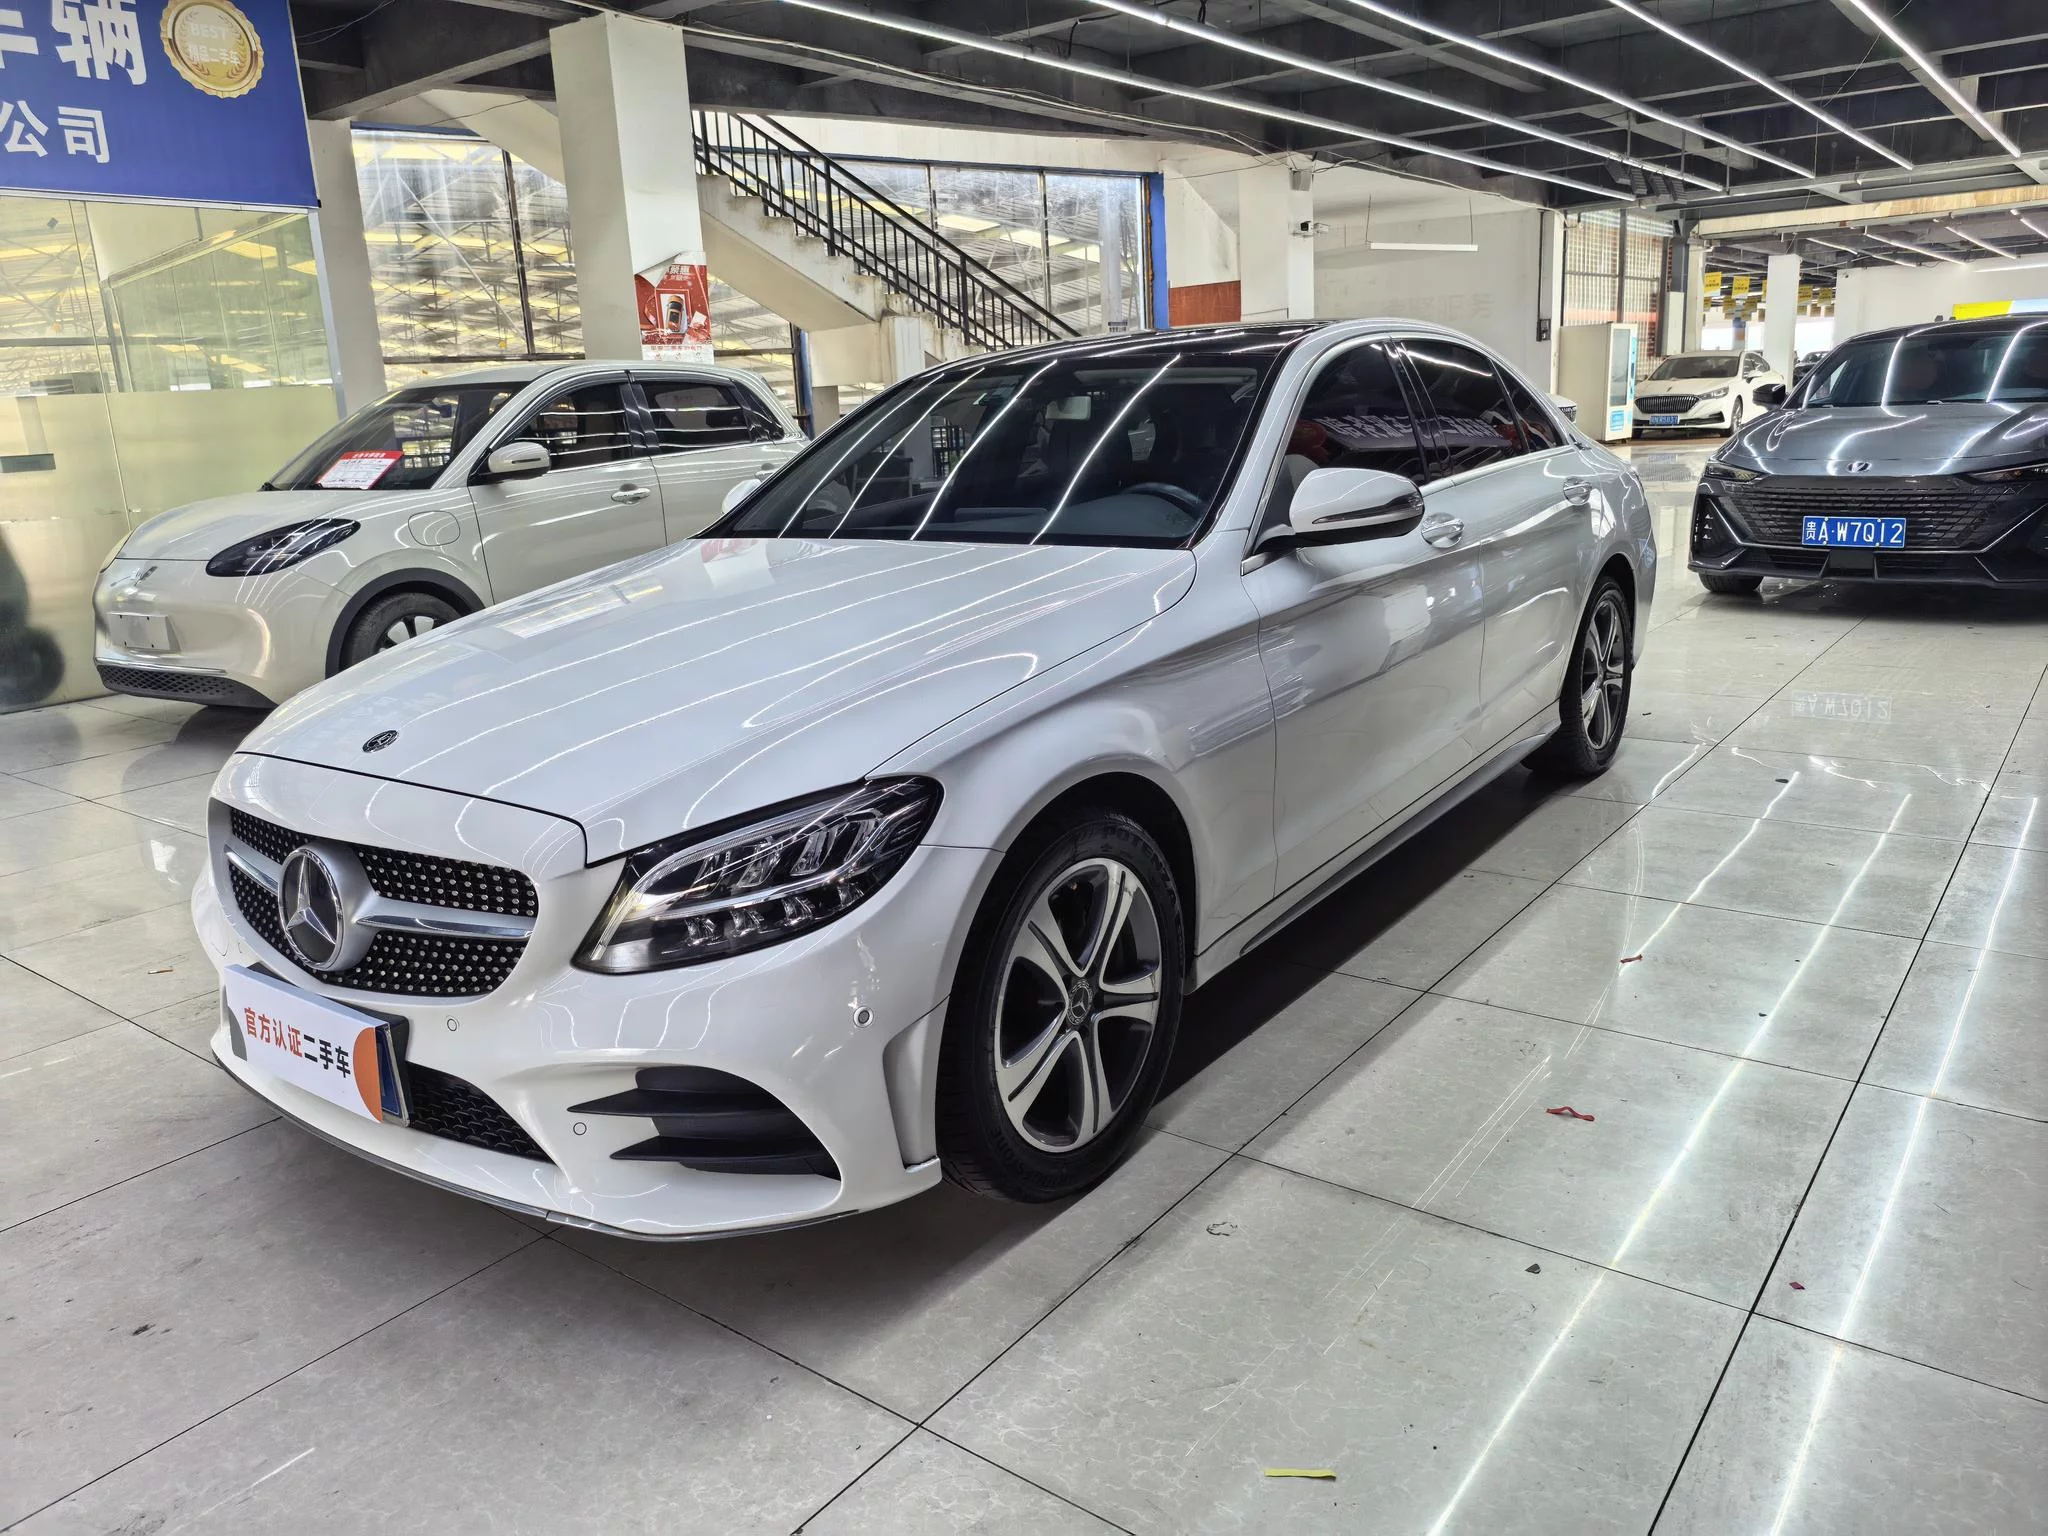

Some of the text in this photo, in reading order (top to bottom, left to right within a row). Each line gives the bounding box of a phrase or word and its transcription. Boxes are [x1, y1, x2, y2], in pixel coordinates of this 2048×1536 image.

[189, 22, 228, 40] BEST
[0, 100, 110, 163] 公司
[244, 1006, 351, 1078] 官方认证二手车
